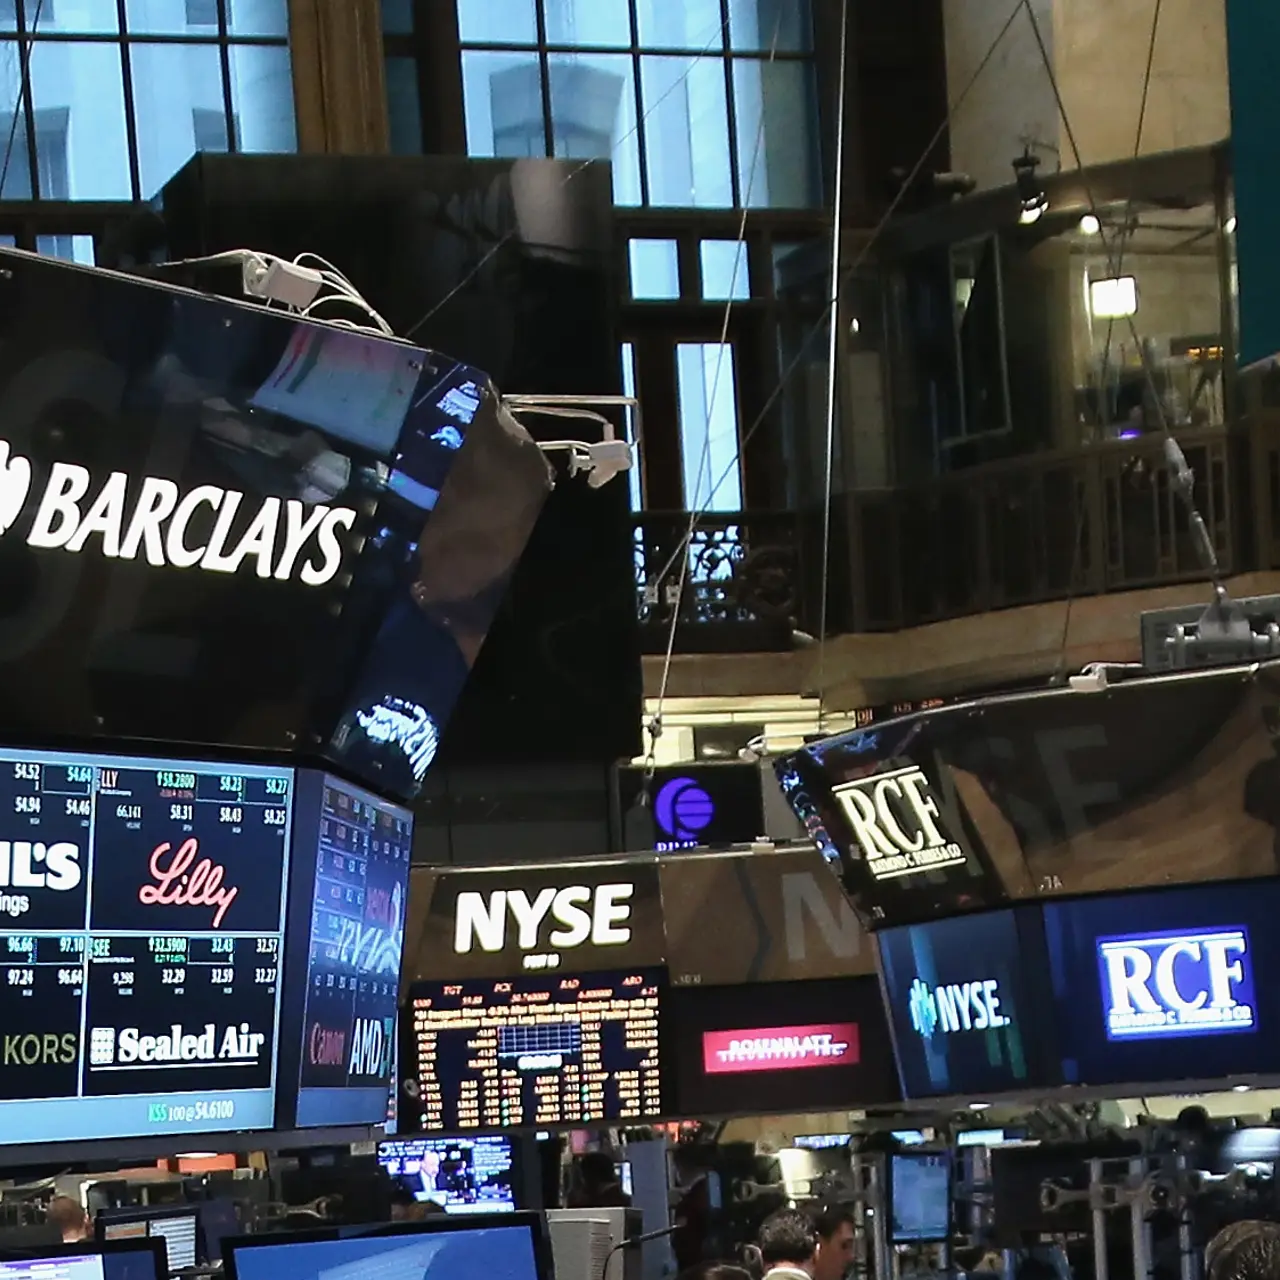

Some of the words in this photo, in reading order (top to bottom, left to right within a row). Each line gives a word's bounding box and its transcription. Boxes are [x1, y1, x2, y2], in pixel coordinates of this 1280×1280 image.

[27, 461, 356, 585] BARCLAYS
[15, 764, 39, 779] 54.52
[68, 766, 91, 782] 54.64
[102, 771, 118, 788] LLY
[66, 800, 89, 815] 54.46
[836, 771, 946, 860] RCF
[140, 838, 238, 928] Lilly
[454, 884, 633, 953] NYSE
[1102, 938, 1246, 1015] RCF
[4, 1033, 77, 1065] KORS
[118, 1024, 216, 1061] Sealed
[219, 1023, 264, 1058] Air
[310, 1022, 345, 1065] Canon
[350, 1018, 382, 1075] AMD
